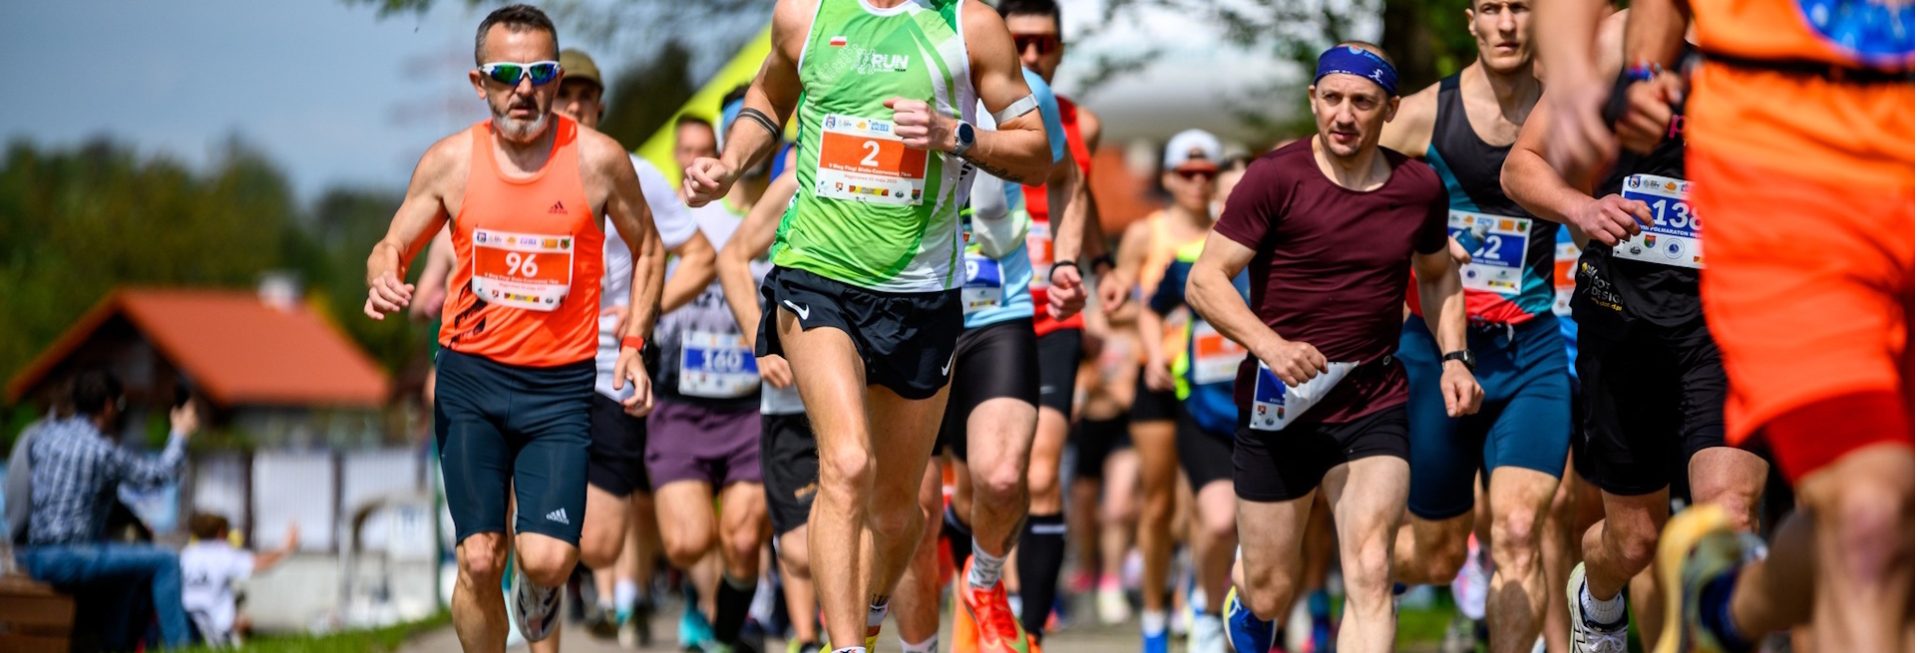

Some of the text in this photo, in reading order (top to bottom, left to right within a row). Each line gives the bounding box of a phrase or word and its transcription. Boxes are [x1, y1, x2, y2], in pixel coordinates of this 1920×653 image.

[872, 54, 909, 69] RUN
[860, 140, 880, 167] 2
[505, 252, 538, 278] 96
[702, 348, 742, 373] 160
